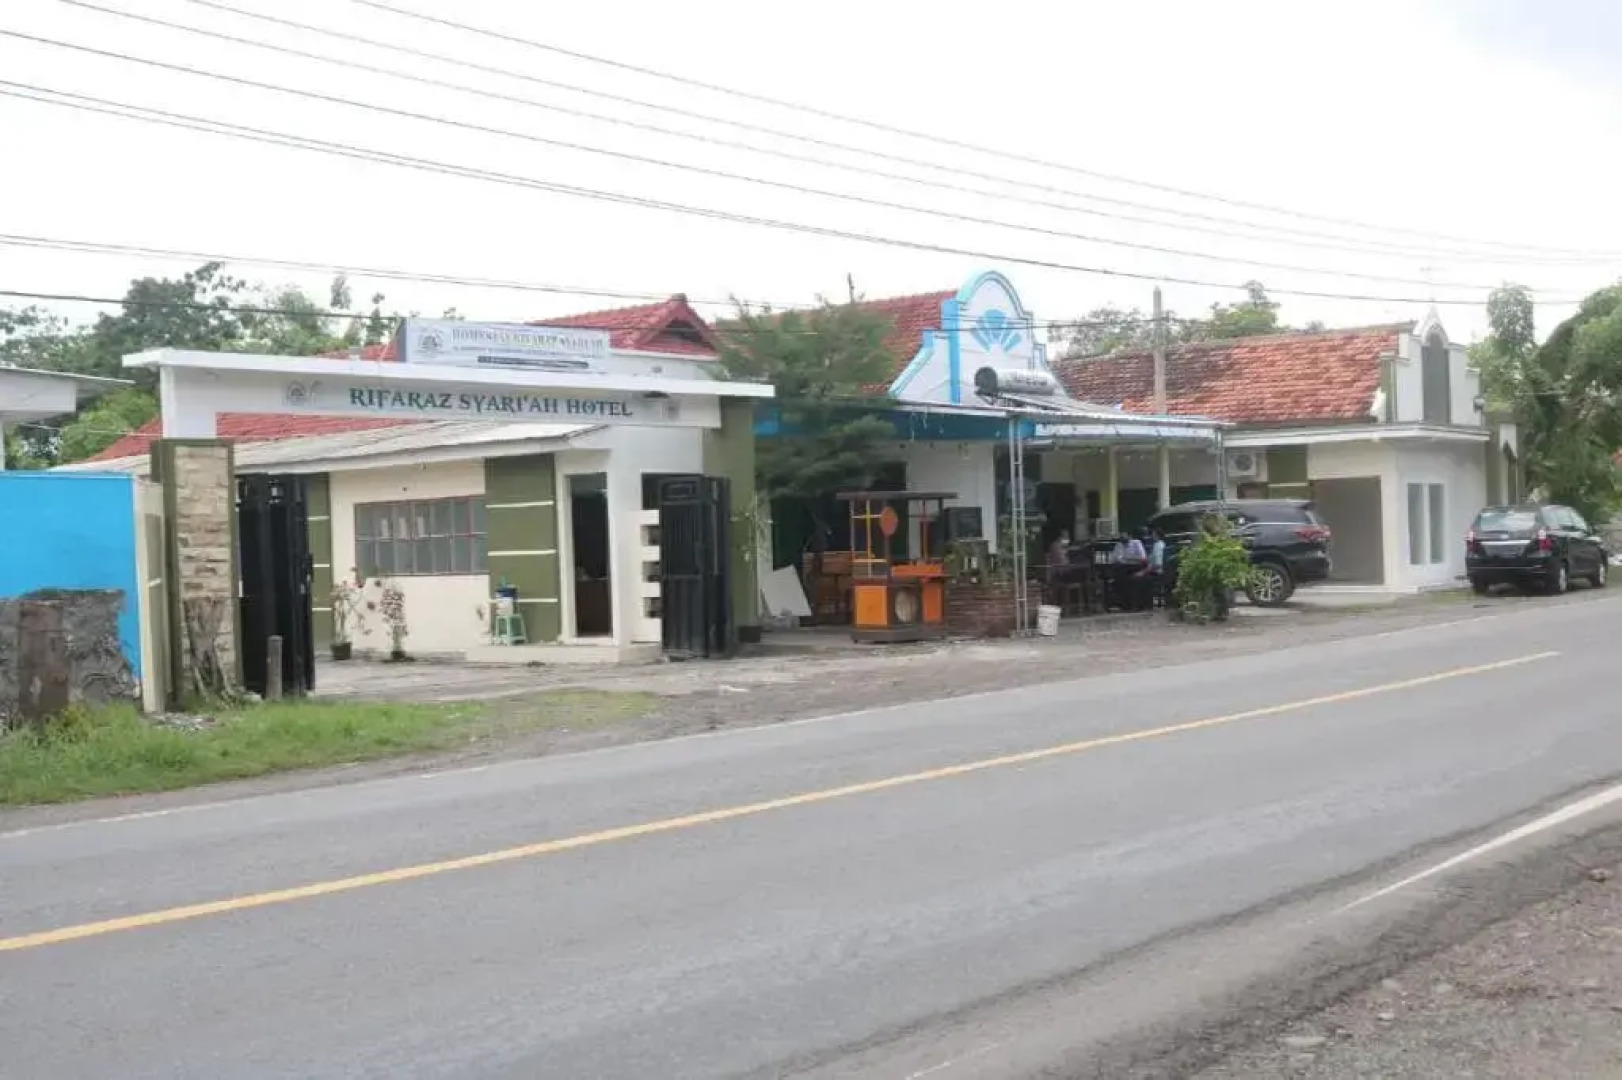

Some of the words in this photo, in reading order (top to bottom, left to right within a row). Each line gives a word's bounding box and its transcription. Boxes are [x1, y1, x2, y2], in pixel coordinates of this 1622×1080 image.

[349, 387, 452, 410] RIFARAZ
[458, 393, 559, 413] SYARI'AH
[566, 398, 633, 416] HOTEL
